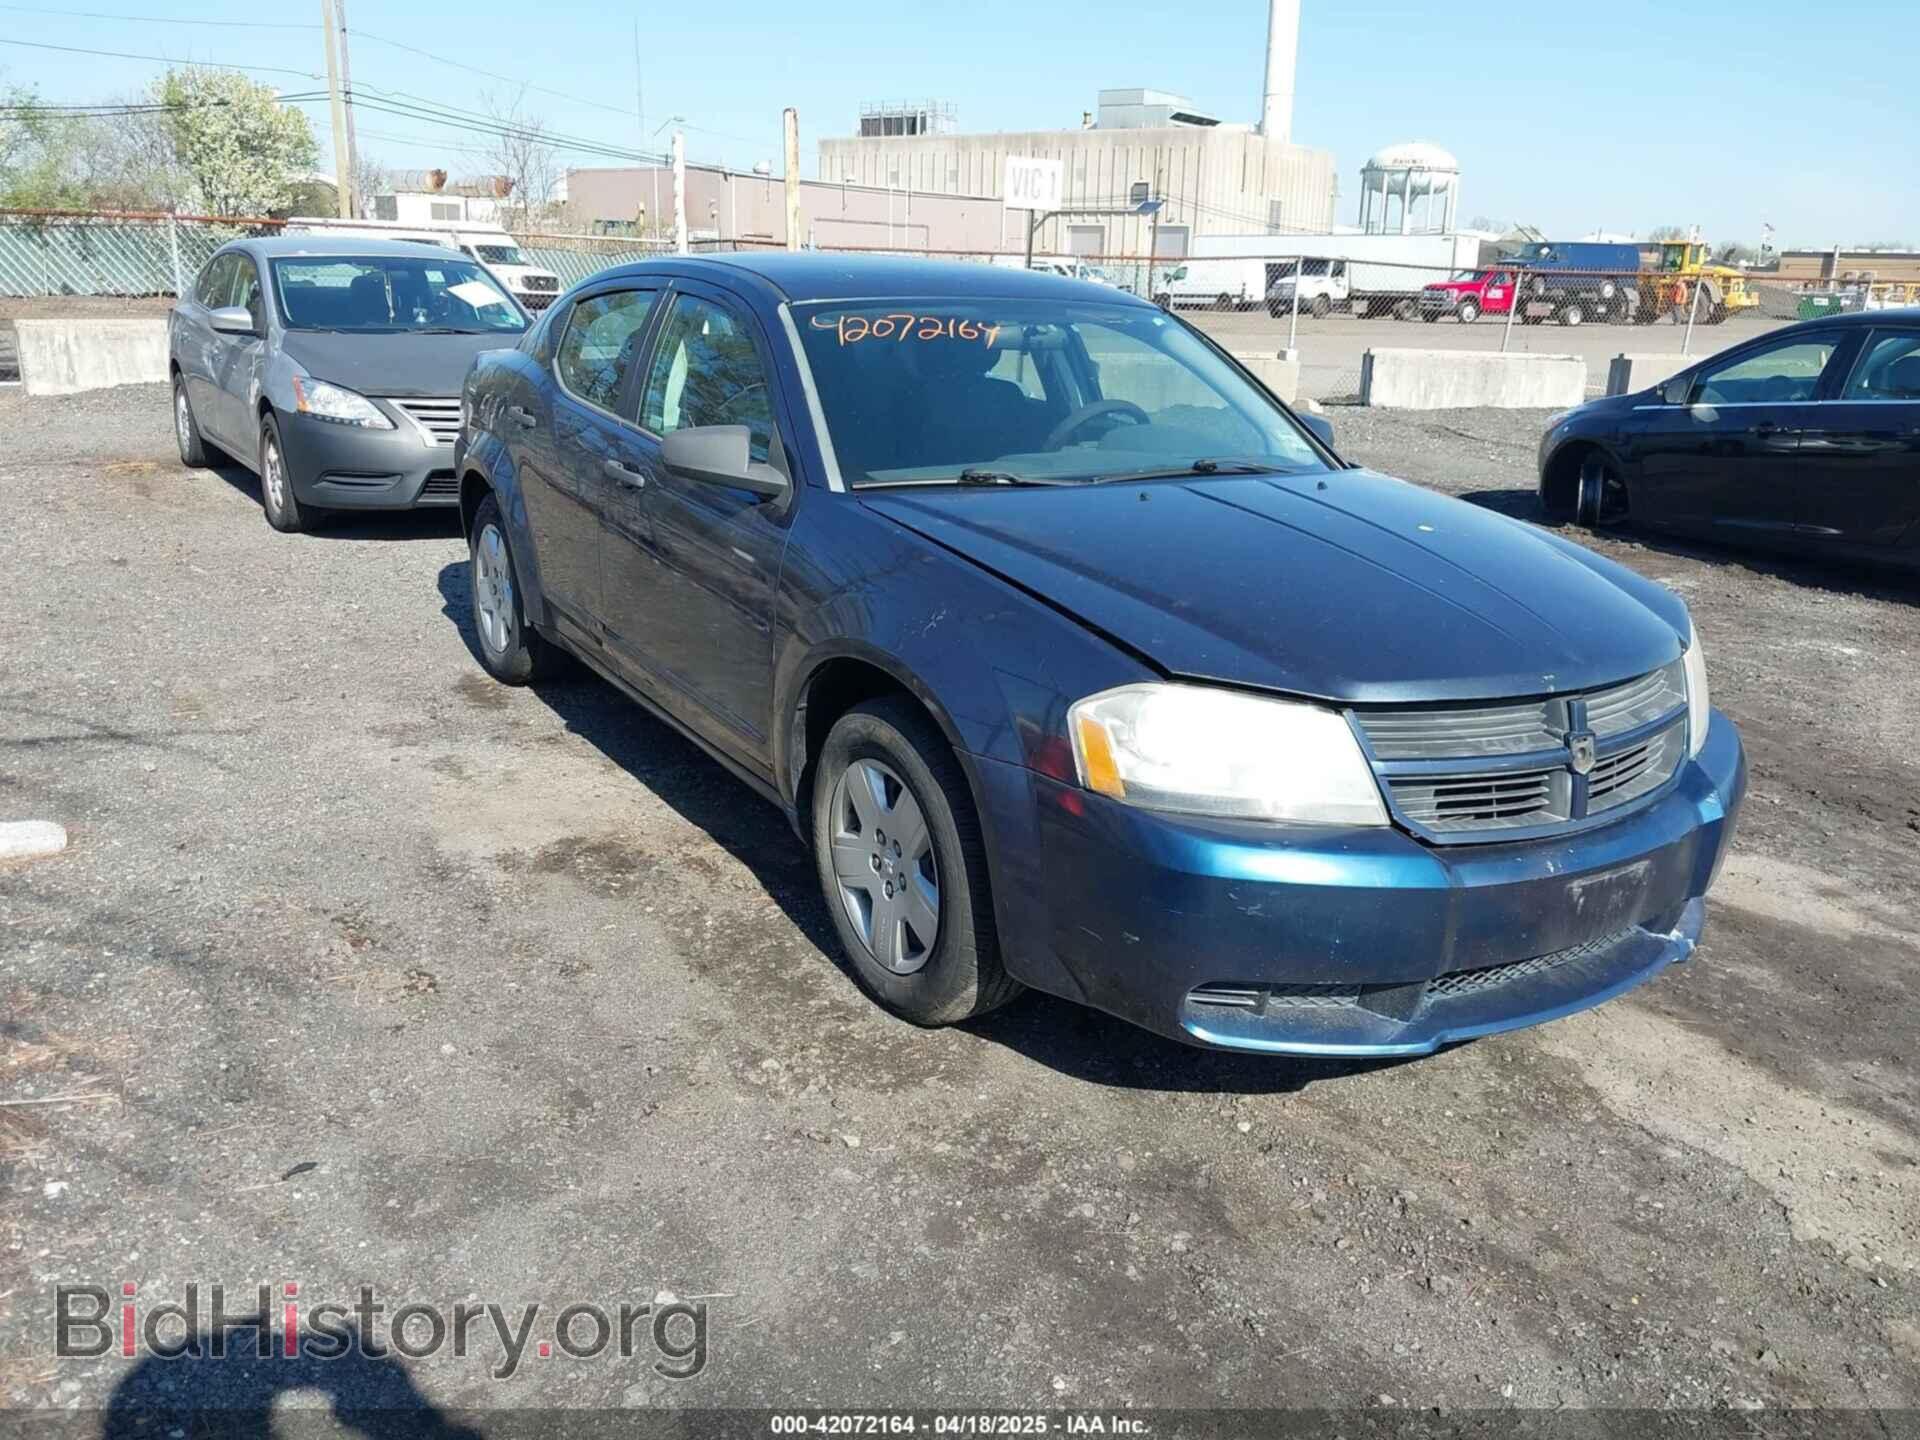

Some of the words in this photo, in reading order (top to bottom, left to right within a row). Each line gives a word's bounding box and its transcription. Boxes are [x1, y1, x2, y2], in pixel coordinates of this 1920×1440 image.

[1012, 167, 1042, 200] VIC
[1050, 170, 1056, 200] 1
[811, 314, 1001, 350] 42072164
